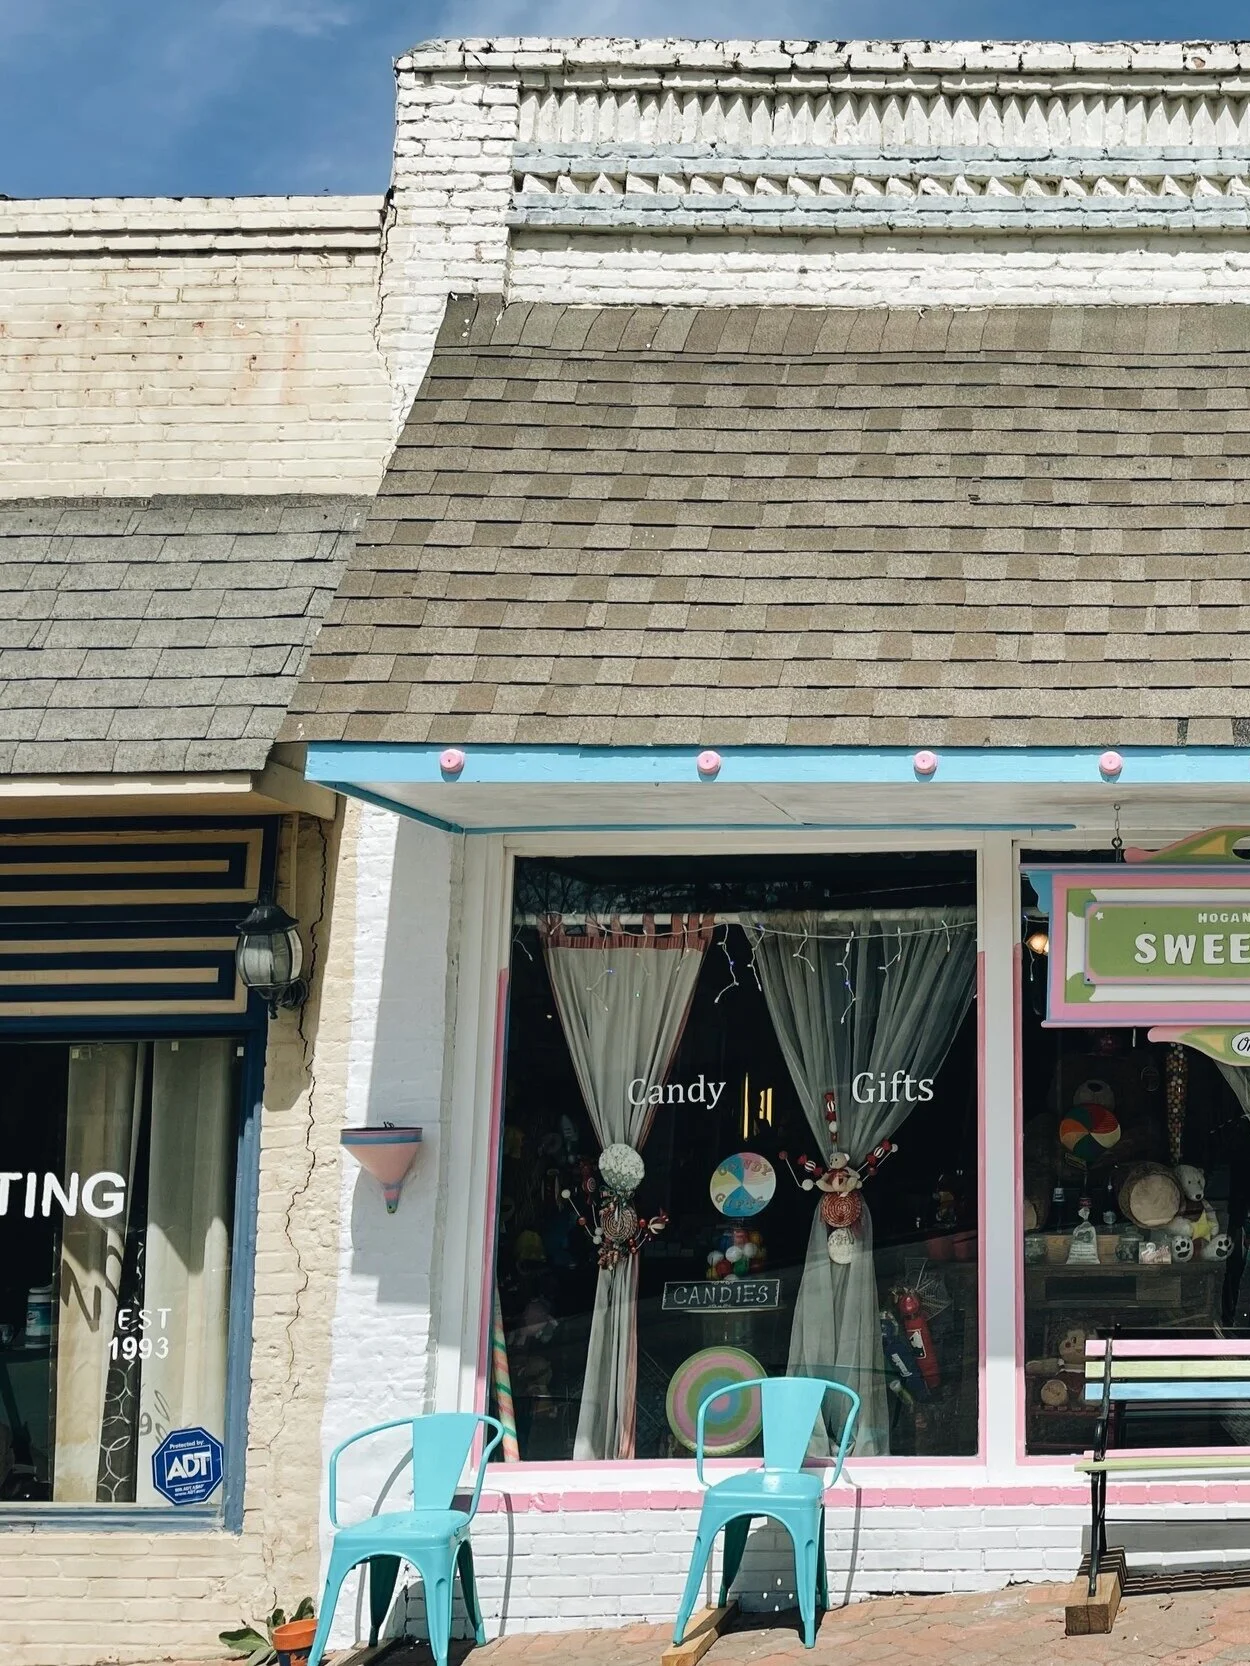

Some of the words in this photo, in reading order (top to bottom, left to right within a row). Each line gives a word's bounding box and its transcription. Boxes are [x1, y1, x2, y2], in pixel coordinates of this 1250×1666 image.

[627, 1074, 727, 1110] Candy
[851, 1069, 935, 1105] Gifts
[673, 1284, 769, 1305] CANDIES
[117, 1308, 172, 1330] EST
[107, 1336, 169, 1361] 1993
[169, 1439, 196, 1450] Protected
[167, 1451, 210, 1481] ADT
